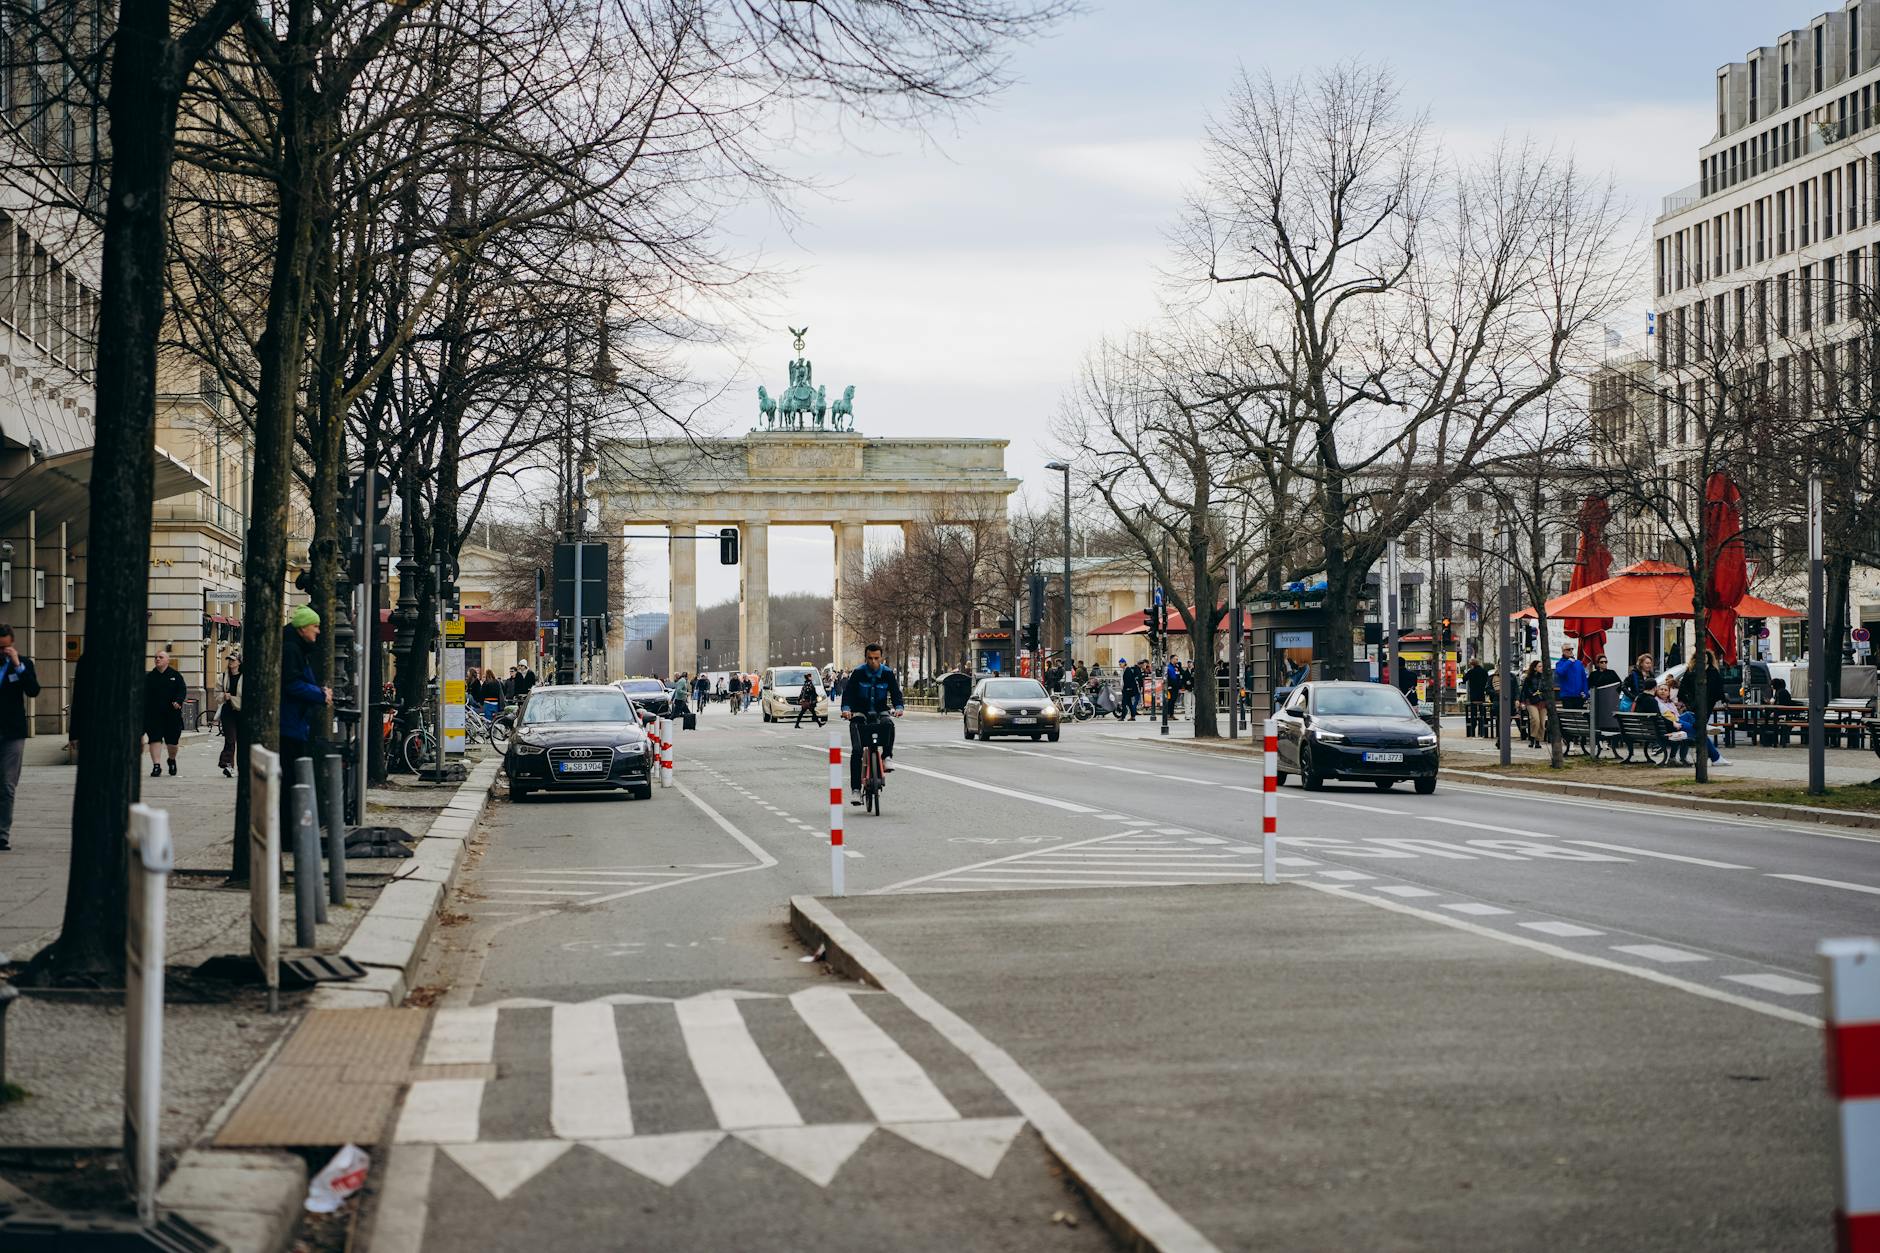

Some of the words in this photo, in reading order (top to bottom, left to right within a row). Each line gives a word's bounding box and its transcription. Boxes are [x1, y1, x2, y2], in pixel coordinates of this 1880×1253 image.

[573, 763, 583, 771] SB
[584, 762, 602, 770] 1904
[1275, 837, 1637, 862] BUS
